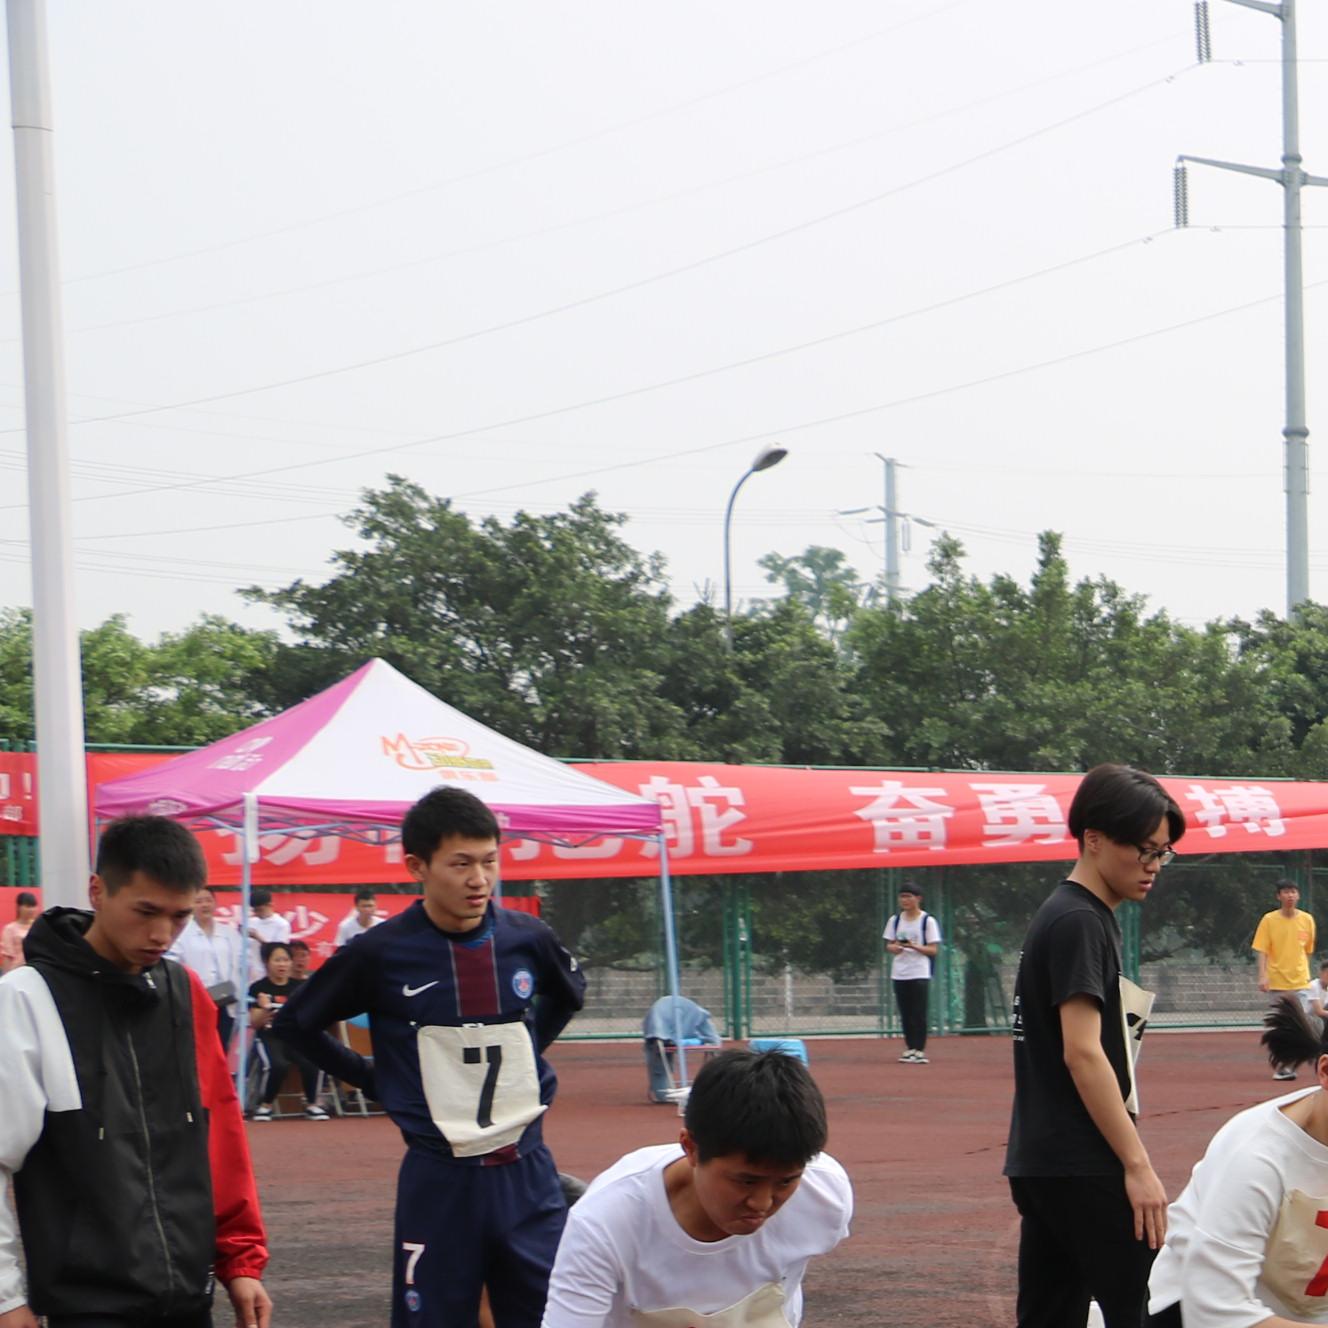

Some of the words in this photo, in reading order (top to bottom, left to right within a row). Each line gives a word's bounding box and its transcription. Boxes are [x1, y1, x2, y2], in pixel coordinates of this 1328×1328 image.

[849, 779, 1287, 854] 奋勇搏
[463, 1045, 502, 1129] 7
[402, 1242, 425, 1284] 7
